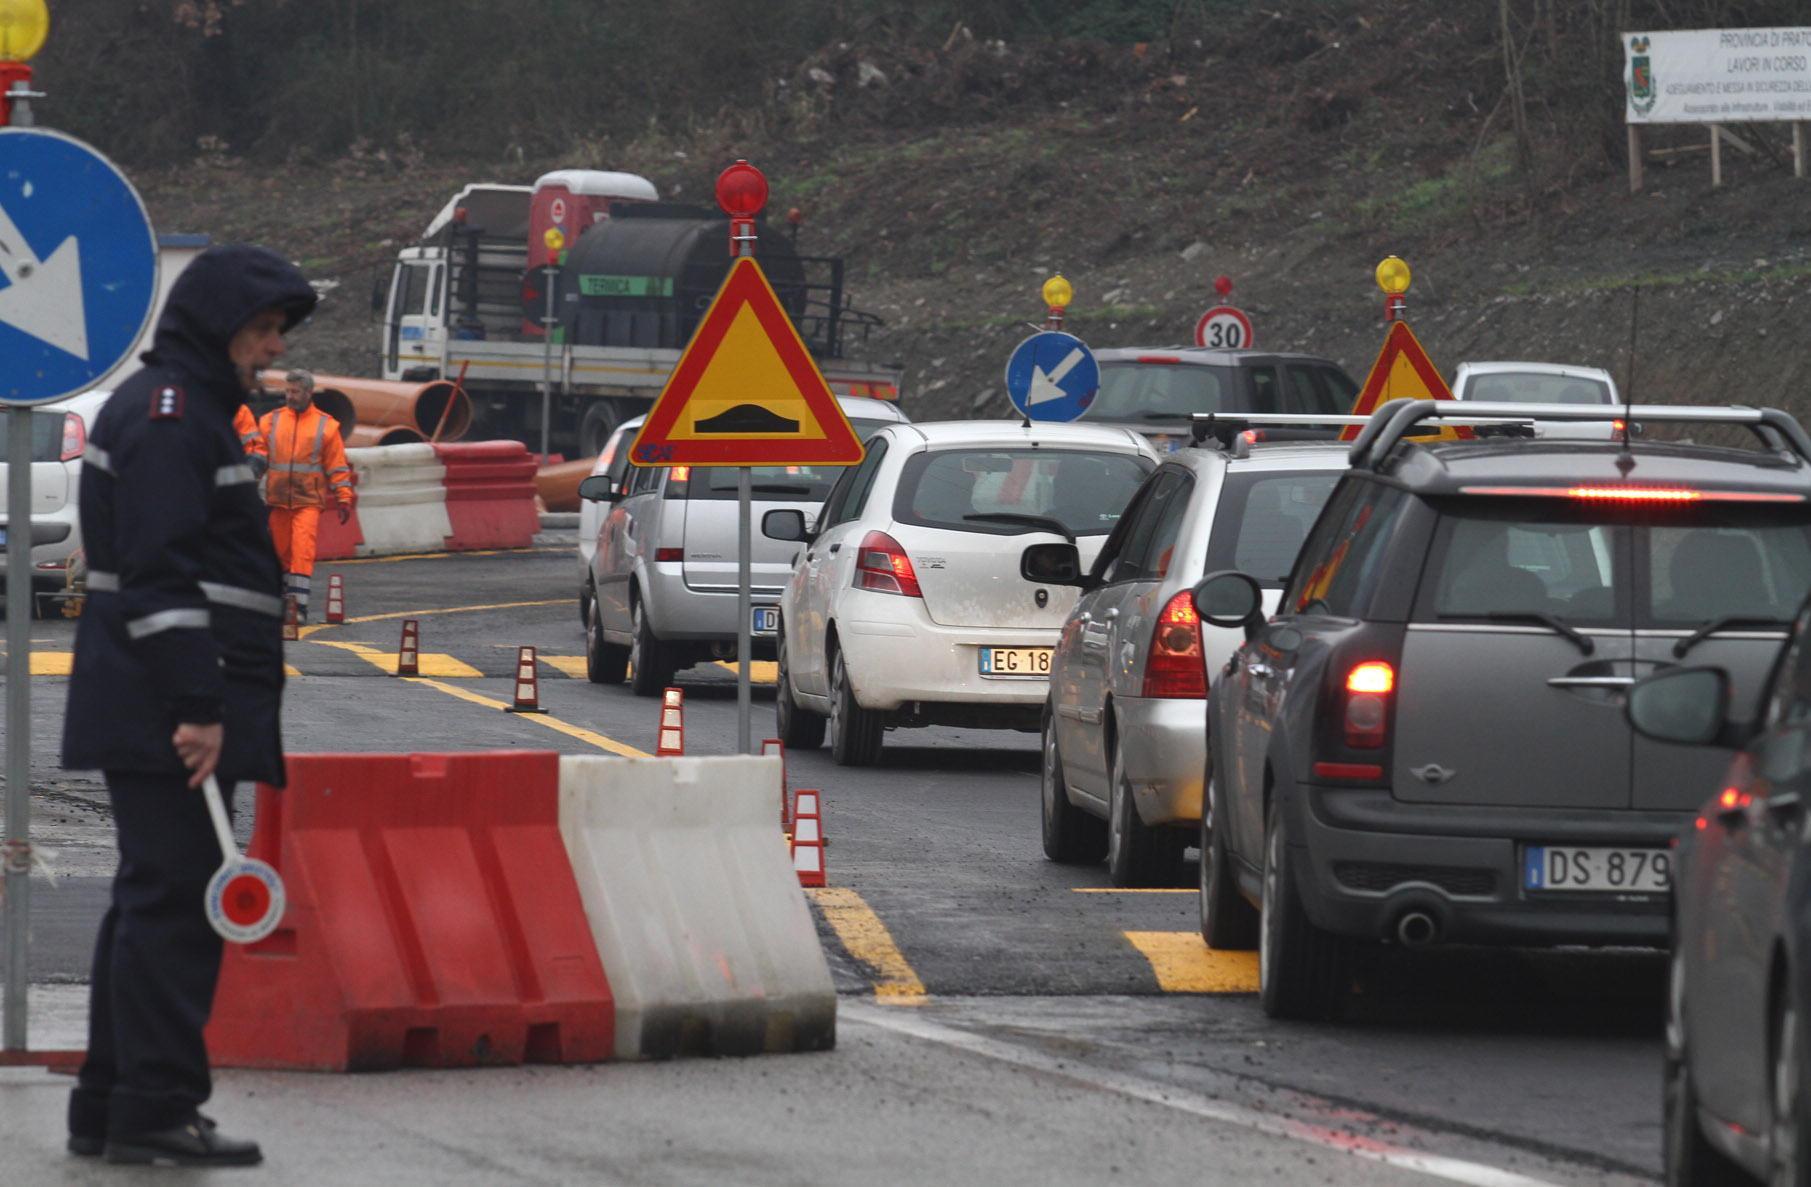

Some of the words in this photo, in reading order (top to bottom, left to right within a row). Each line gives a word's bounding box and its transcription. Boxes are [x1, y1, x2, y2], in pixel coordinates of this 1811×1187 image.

[1720, 31, 1768, 48] PROVINCIA
[1770, 31, 1780, 47] DI
[1727, 57, 1760, 73] LAVORI
[1762, 56, 1773, 71] IN
[1774, 55, 1807, 72] CORSO
[1210, 322, 1240, 348] 30
[994, 650, 1018, 671] EG
[1028, 651, 1049, 672] 18
[1550, 850, 1591, 885] DS
[1607, 852, 1671, 888] 879
